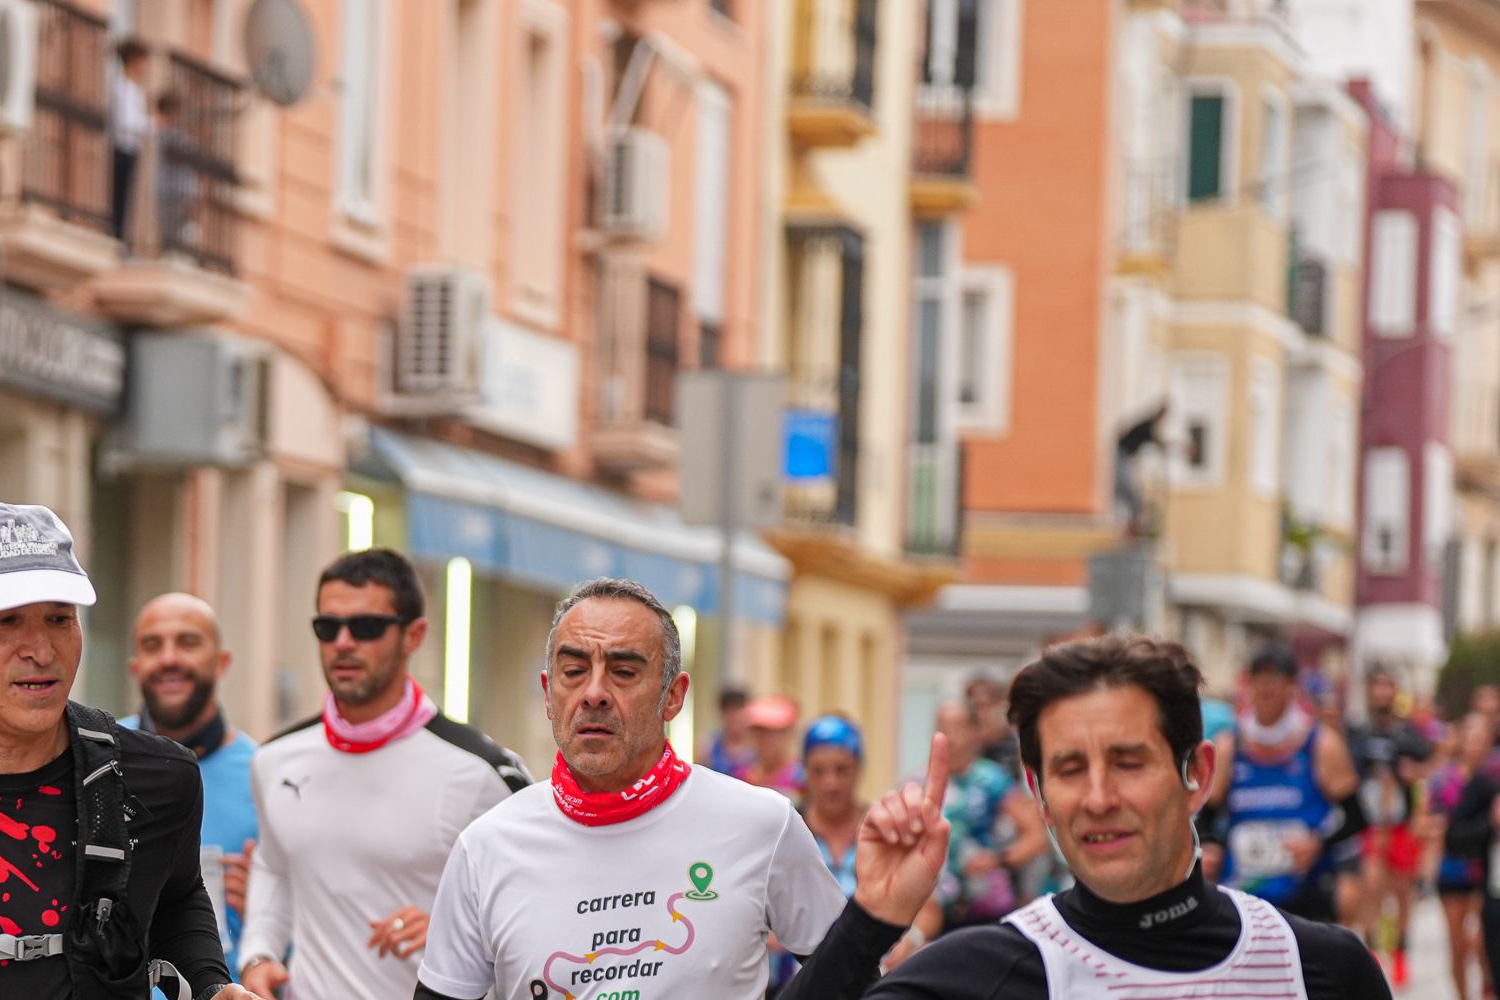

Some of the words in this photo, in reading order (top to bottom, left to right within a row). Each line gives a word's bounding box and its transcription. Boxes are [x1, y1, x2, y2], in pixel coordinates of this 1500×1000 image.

[576, 890, 656, 915] carrera
[1140, 896, 1199, 929] Joma
[591, 926, 642, 951] para
[570, 958, 663, 986] recordar
